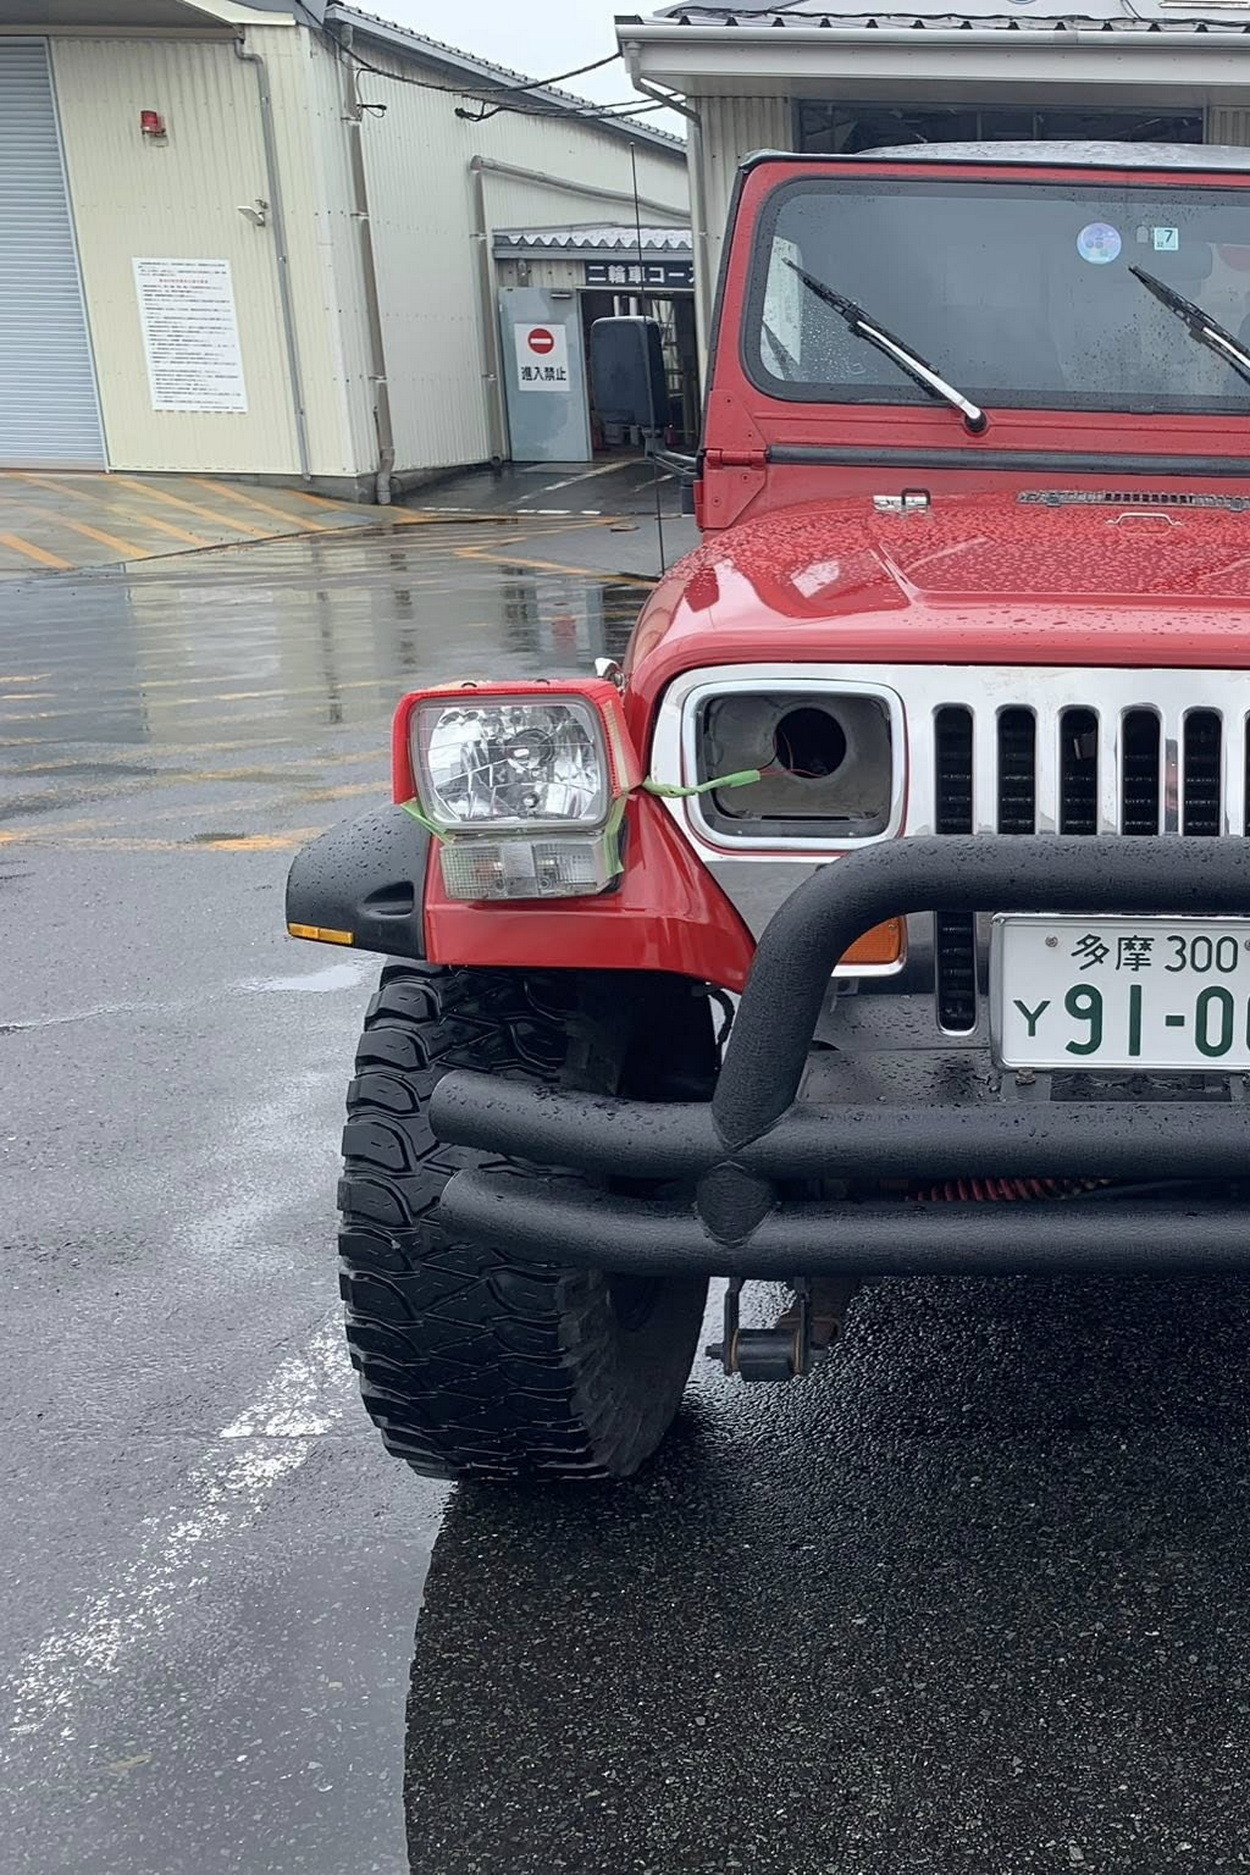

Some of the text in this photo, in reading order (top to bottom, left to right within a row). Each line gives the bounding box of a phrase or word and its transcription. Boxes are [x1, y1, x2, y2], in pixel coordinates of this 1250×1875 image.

[1164, 229, 1174, 244] 7
[521, 366, 567, 381] 進入禁止
[1071, 933, 1239, 973] 多摩 300
[1013, 999, 1051, 1037] Y
